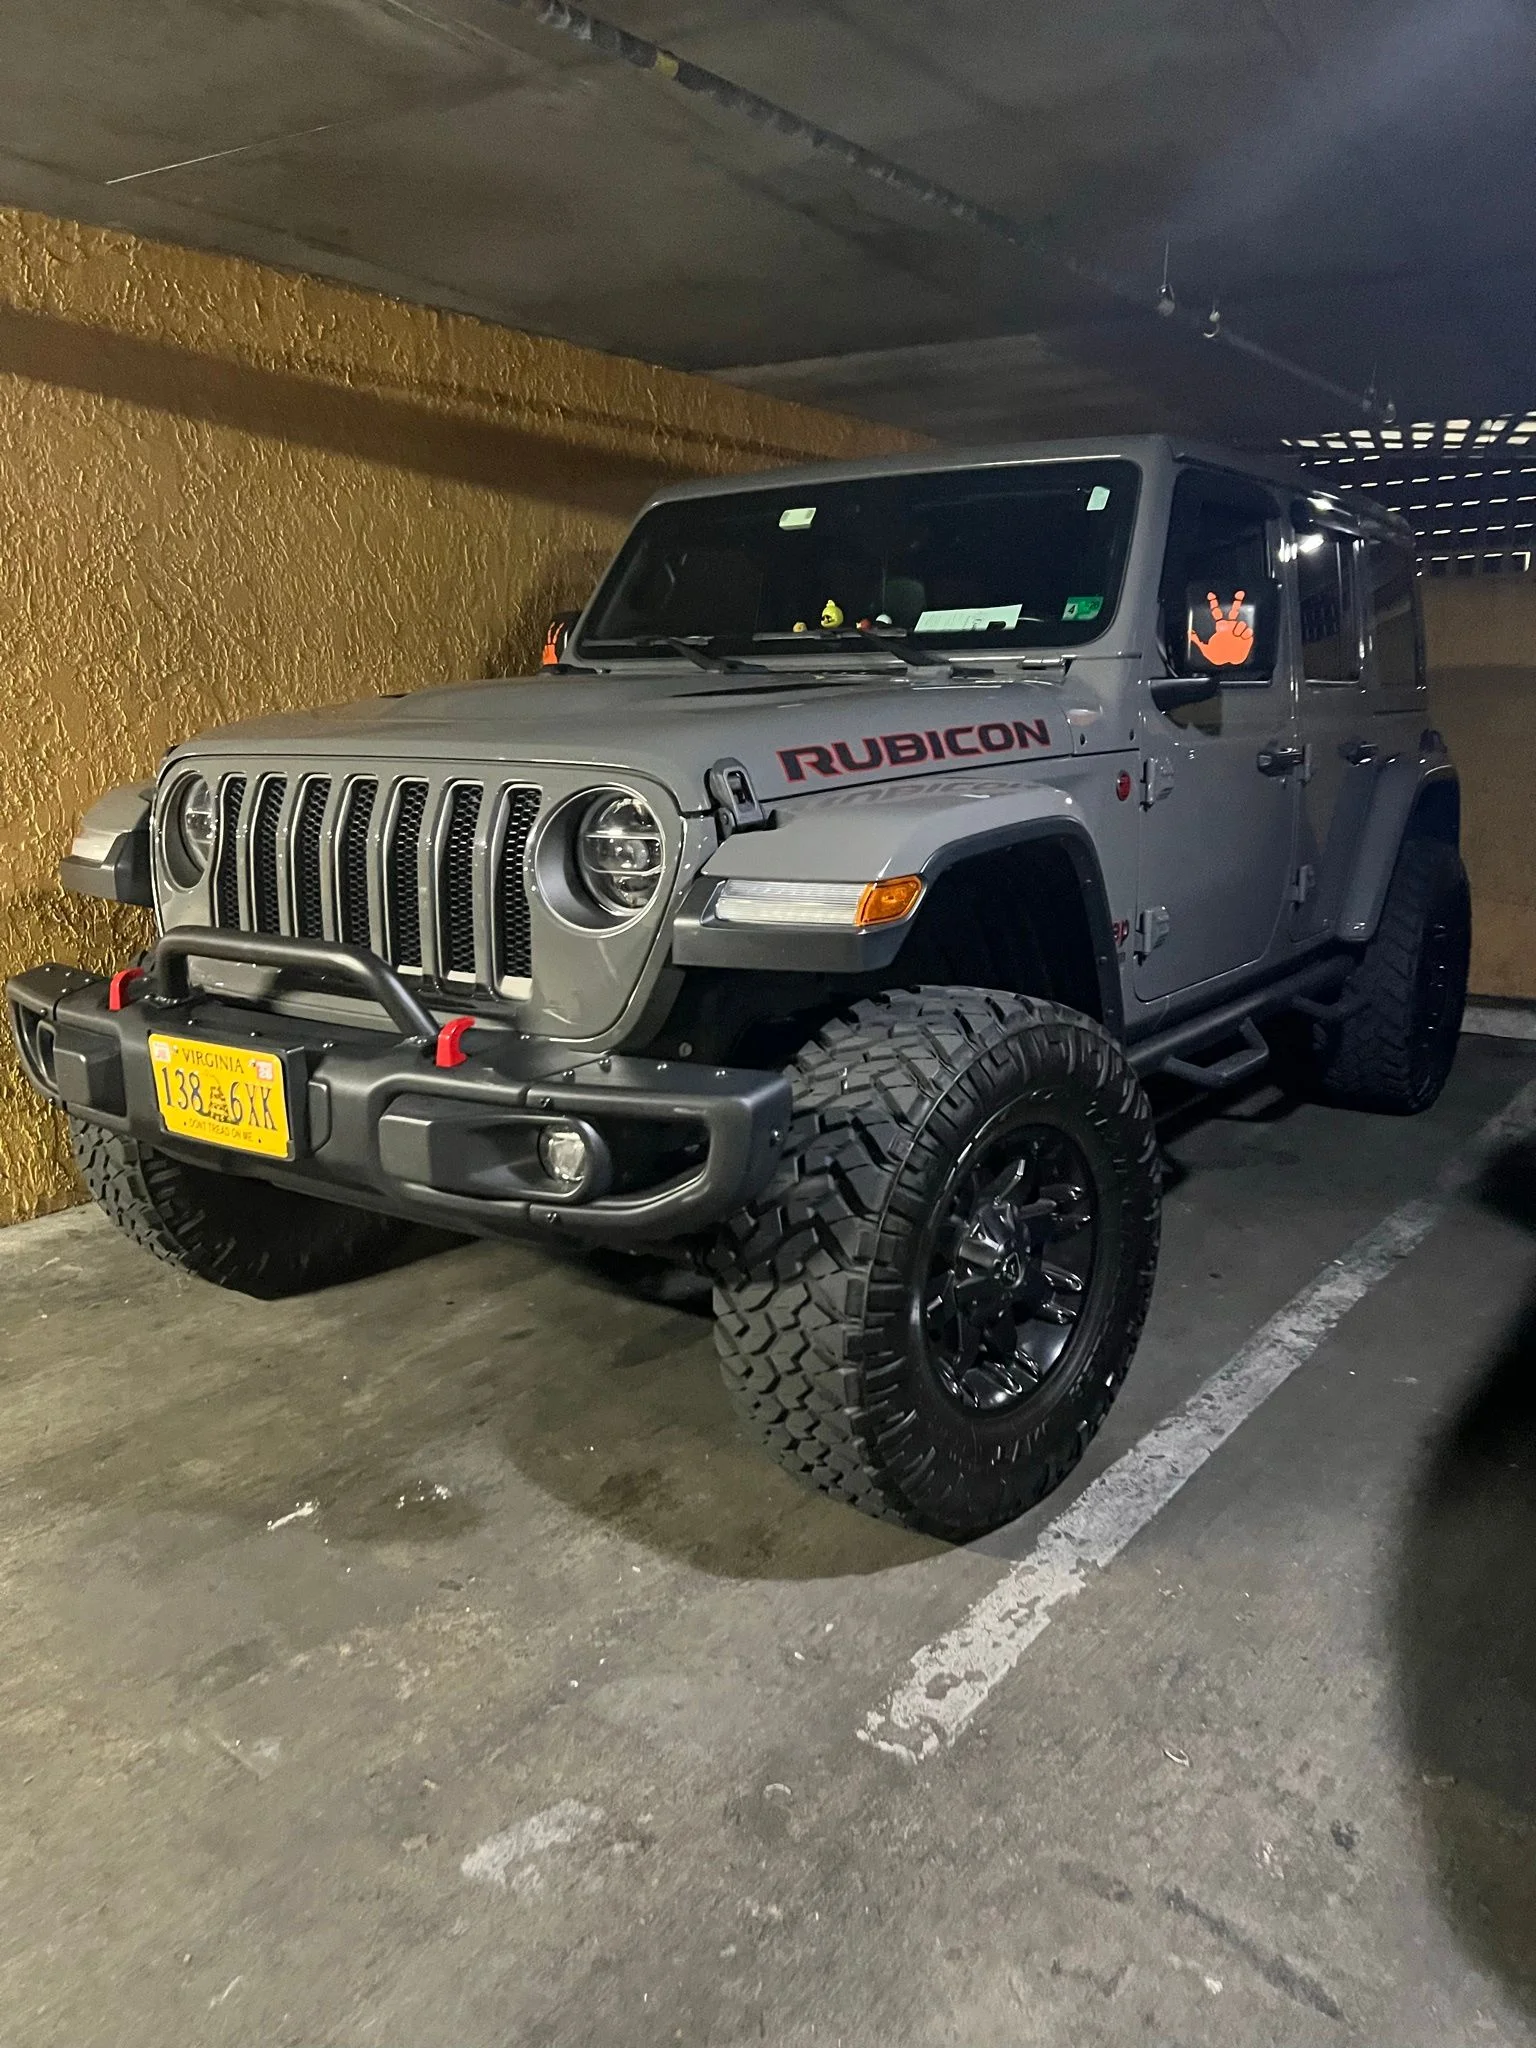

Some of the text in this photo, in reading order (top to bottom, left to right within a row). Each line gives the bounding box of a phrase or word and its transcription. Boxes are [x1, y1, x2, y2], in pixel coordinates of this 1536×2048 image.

[776, 719, 1051, 783] RUBICON
[181, 1047, 244, 1074] VIRGINIA
[161, 1066, 204, 1114] 138
